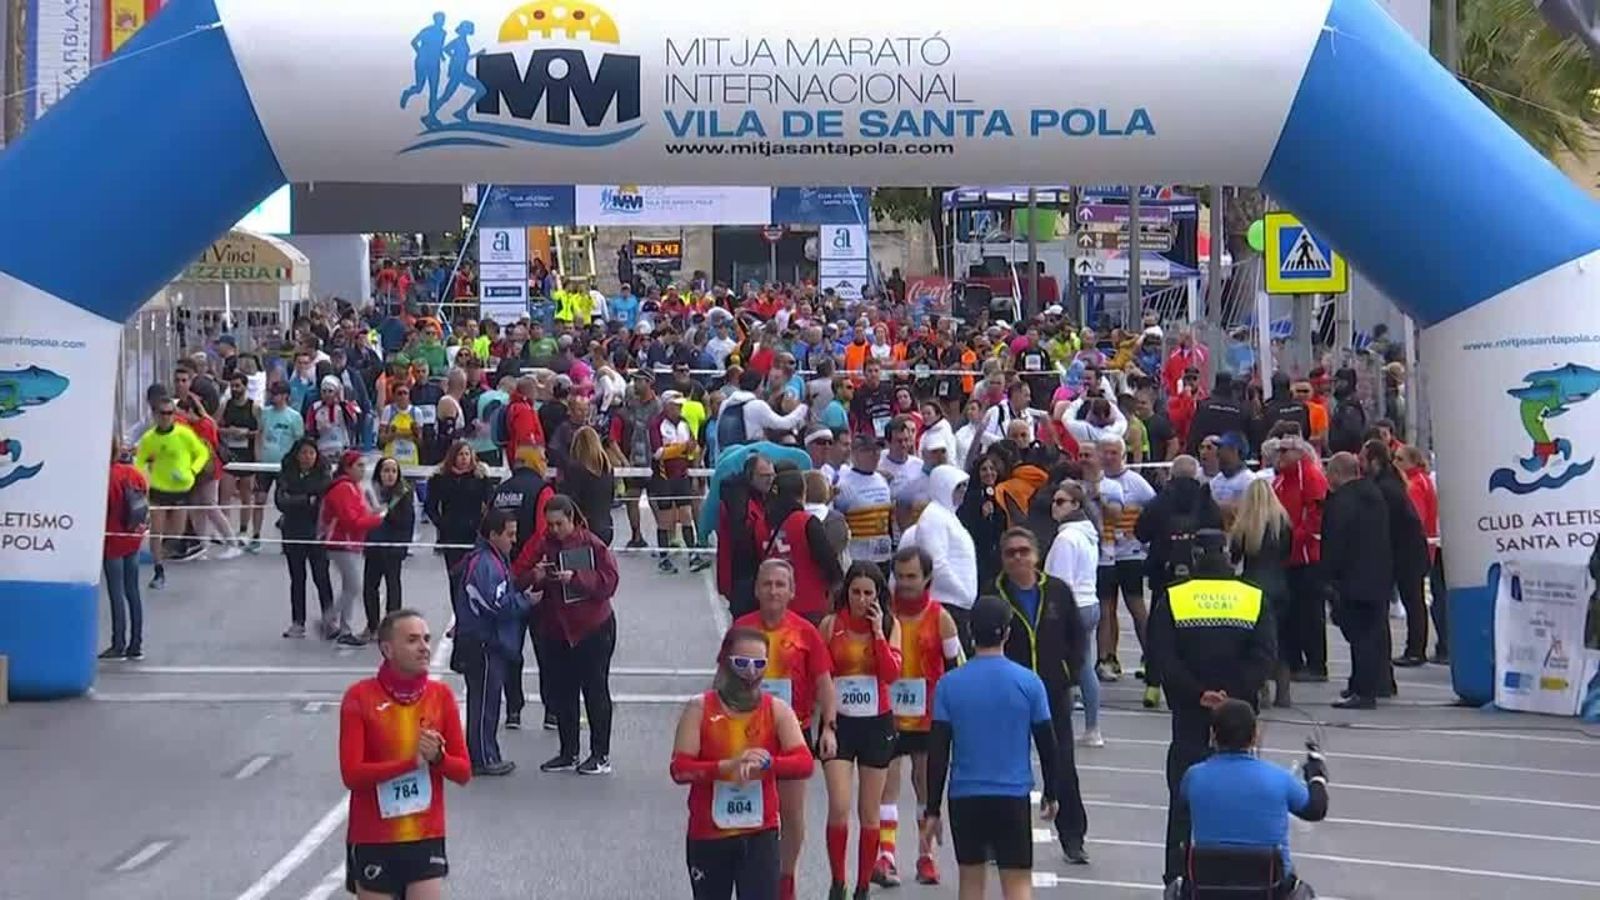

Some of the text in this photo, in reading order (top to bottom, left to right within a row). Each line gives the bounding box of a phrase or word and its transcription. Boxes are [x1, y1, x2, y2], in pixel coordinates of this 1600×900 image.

[664, 31, 951, 67] MITJA MARATÓ
[664, 74, 975, 104] INTERNACIONAL
[664, 108, 1156, 138] VILA DE SANTA POLA
[665, 141, 954, 157] www.mitjasantapola.com
[211, 243, 256, 263] Vinci
[1478, 512, 1524, 532] CLUB
[2, 534, 55, 551] POLA
[1496, 534, 1560, 552] SANTA
[1197, 601, 1234, 610] LOCAL
[842, 692, 871, 704] 2000
[393, 783, 419, 801] 784
[727, 800, 752, 814] 804
